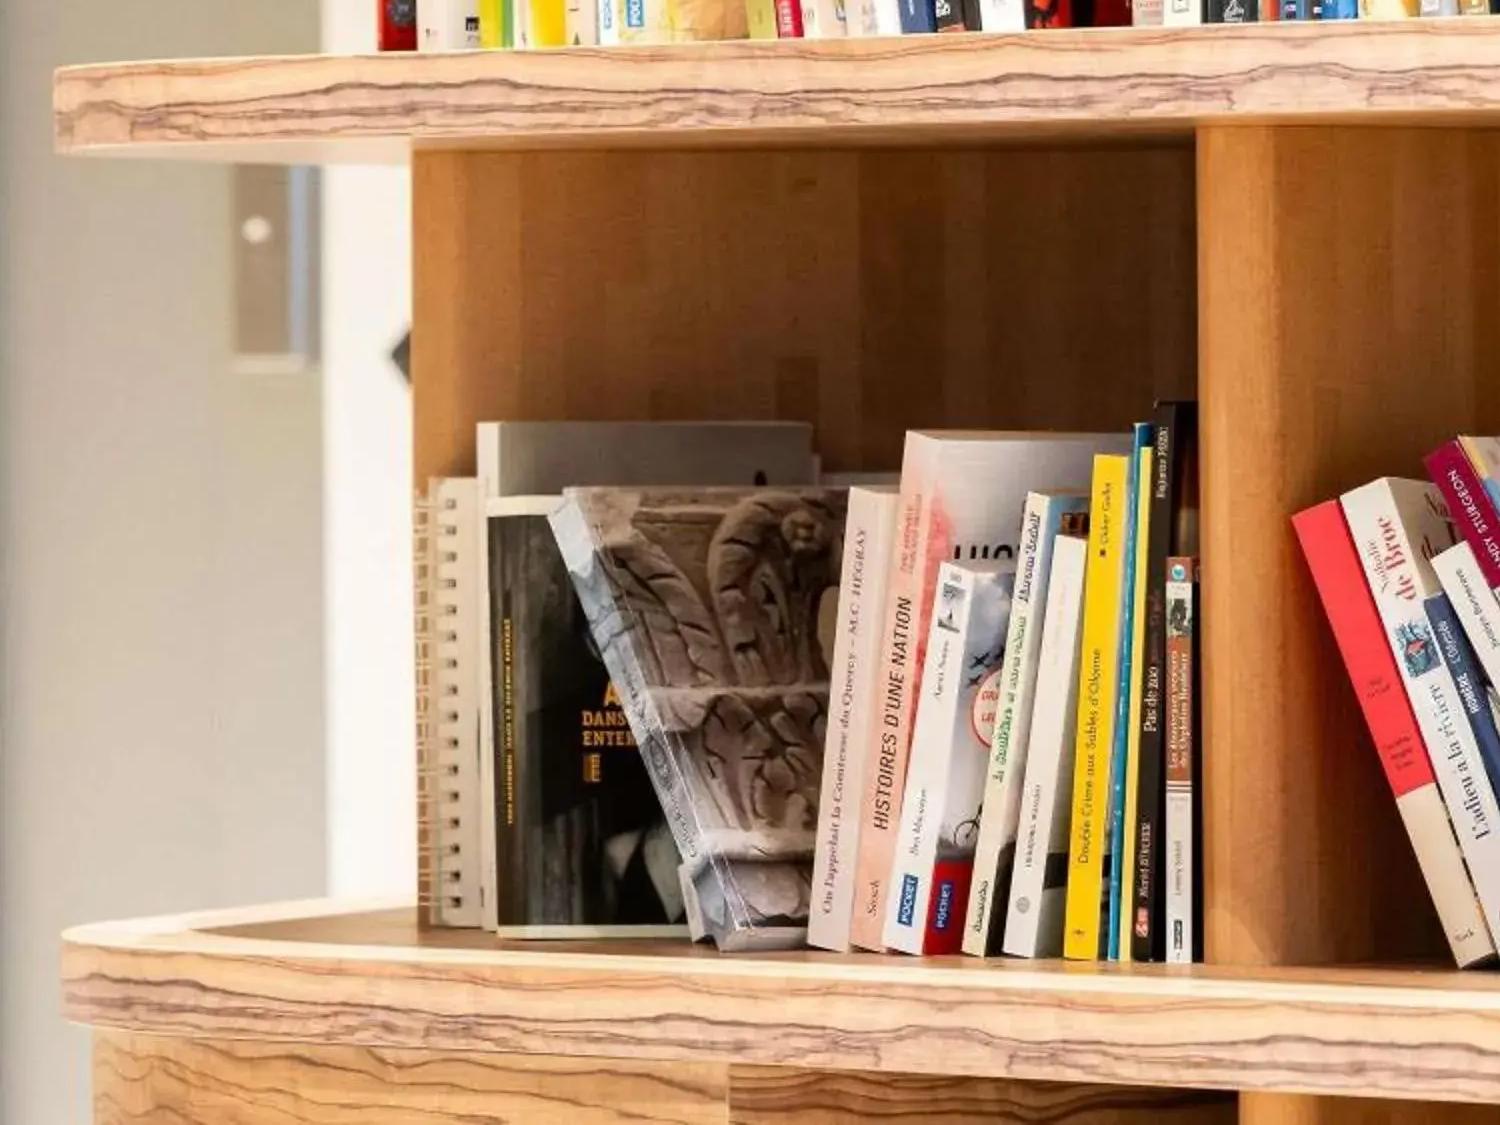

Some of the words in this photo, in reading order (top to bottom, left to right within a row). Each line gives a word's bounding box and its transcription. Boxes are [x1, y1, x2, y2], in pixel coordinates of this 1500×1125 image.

[1447, 468, 1488, 534] STURGEON
[1377, 516, 1408, 569] Broc
[1366, 538, 1391, 594] Nathalie
[1395, 574, 1418, 601] de
[890, 596, 912, 667] NATION
[884, 671, 904, 728] D'UNE
[1144, 690, 1158, 706] de
[1427, 684, 1458, 739] rivière
[1457, 672, 1480, 713] HOMÈRE
[839, 709, 851, 728] du
[1086, 711, 1099, 749] Sables
[1142, 707, 1158, 732] Pas
[833, 732, 849, 802] Comtesse
[1086, 754, 1096, 777] aux
[1169, 752, 1177, 768] Les
[1447, 740, 1465, 759] la
[873, 733, 898, 831] HISTOIRES
[1081, 781, 1094, 817] Crime
[830, 806, 841, 819] la
[1462, 775, 1492, 840] L'adieu
[824, 823, 841, 887] l'appelait
[1077, 820, 1092, 863] Double
[823, 890, 833, 913] On
[867, 879, 880, 916] Stock
[901, 876, 917, 924] POCKET
[936, 883, 952, 928] POCKET
